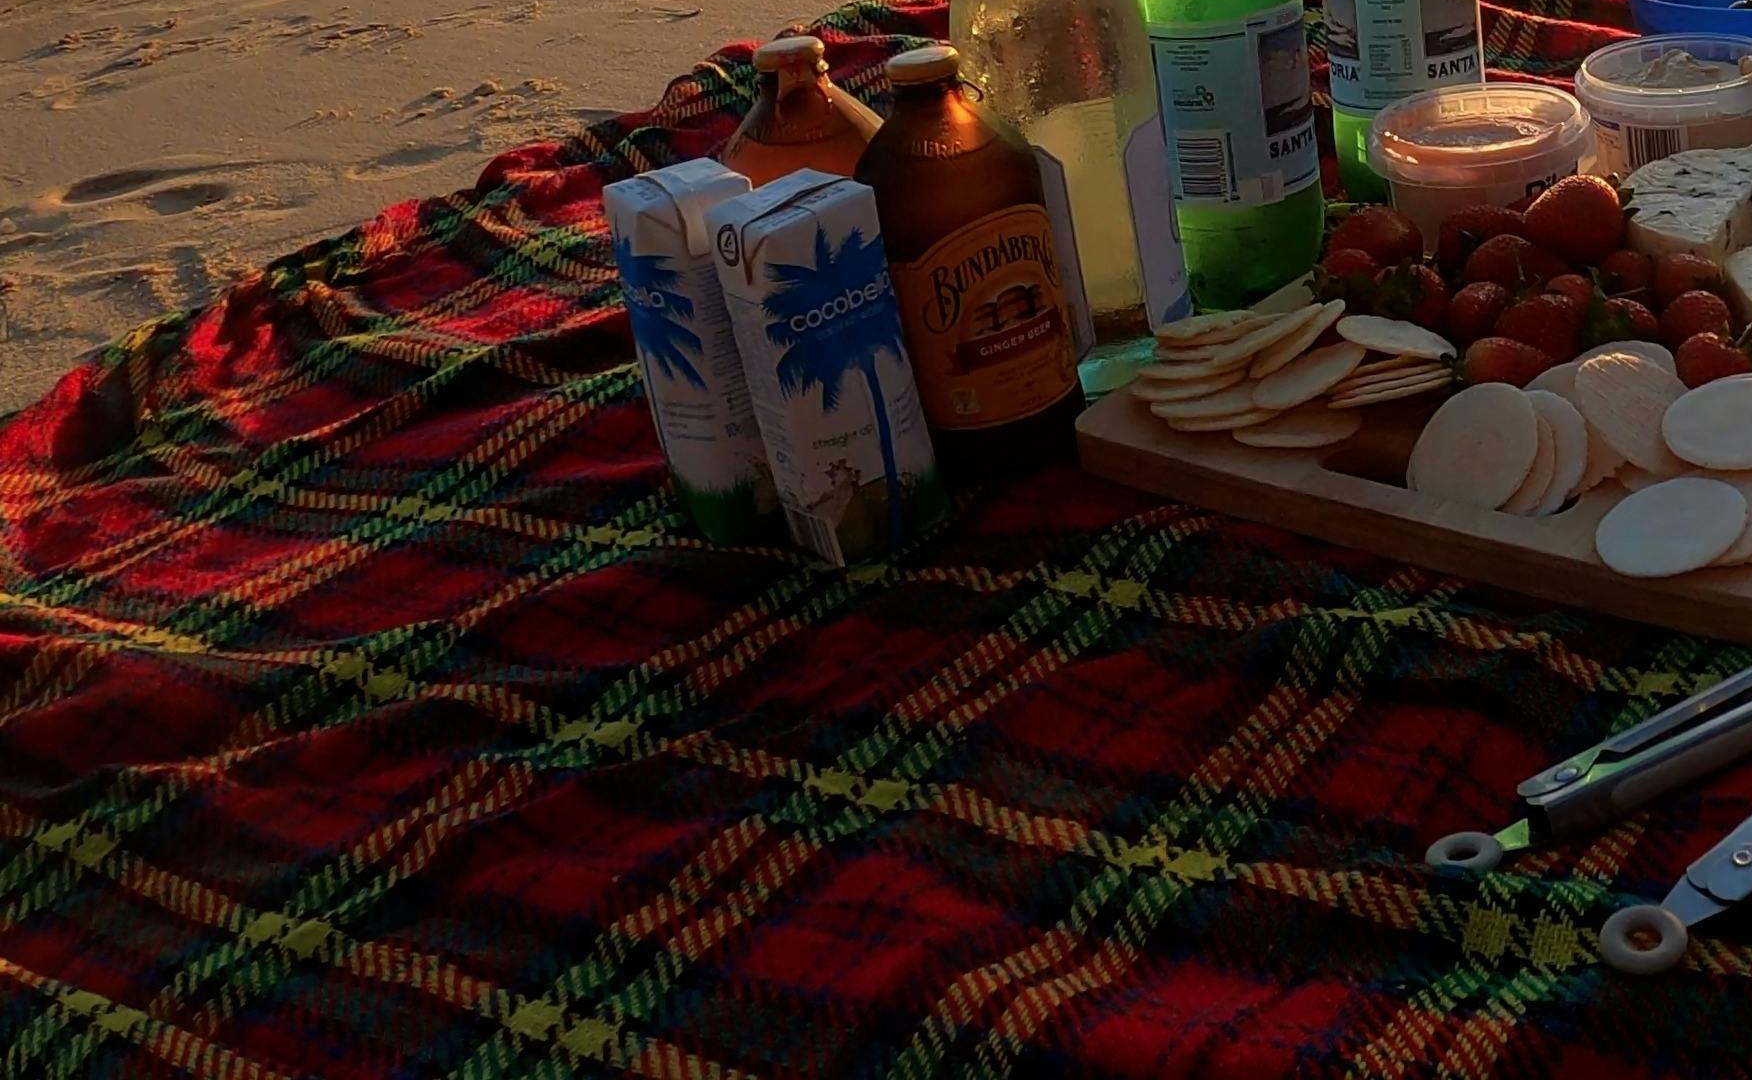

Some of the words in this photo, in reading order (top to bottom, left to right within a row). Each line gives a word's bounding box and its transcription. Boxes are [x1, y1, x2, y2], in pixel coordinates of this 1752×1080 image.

[1427, 54, 1475, 79] SANTA
[1269, 127, 1313, 159] SANTA
[922, 228, 1059, 334] BUNDABERG
[978, 333, 1025, 357] GINGER
[1026, 320, 1052, 340] BEER
